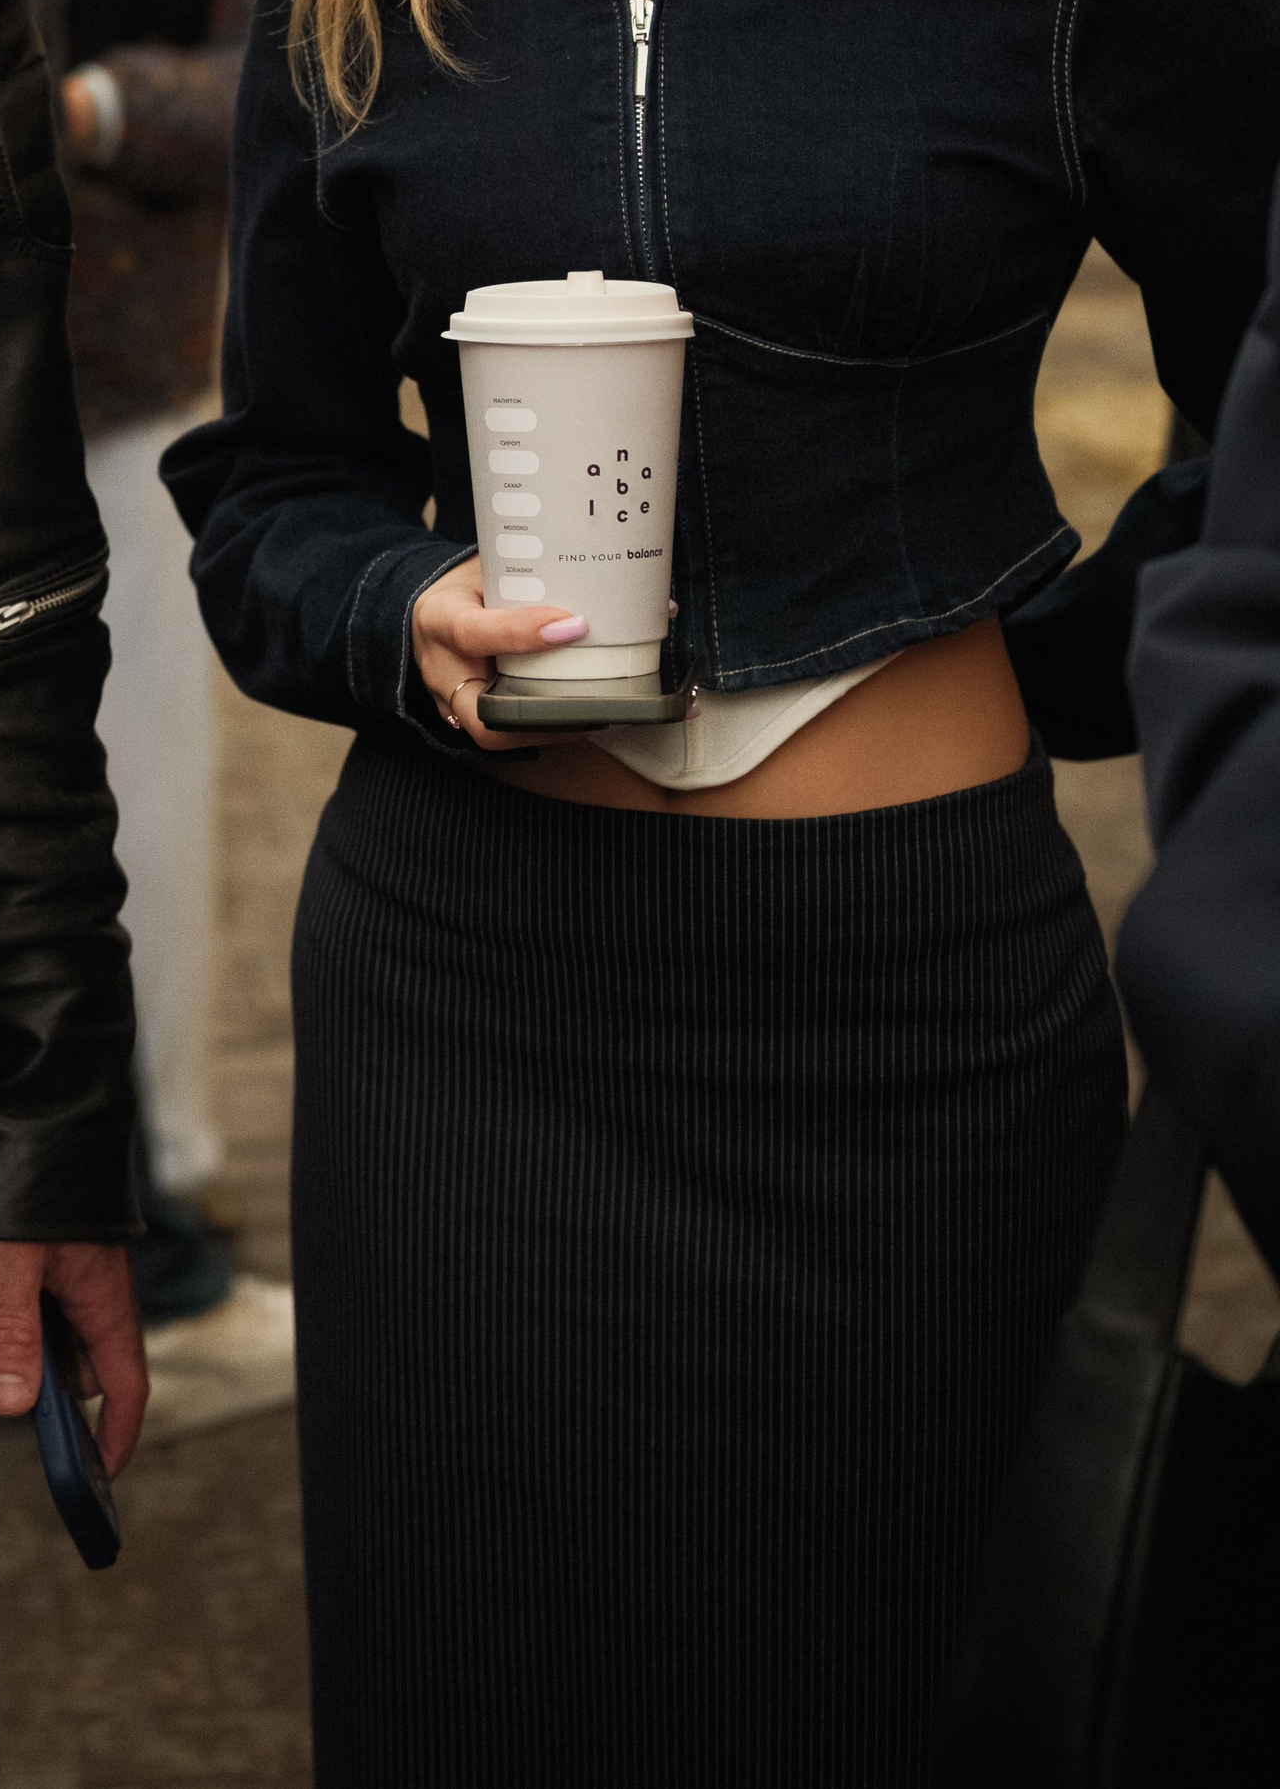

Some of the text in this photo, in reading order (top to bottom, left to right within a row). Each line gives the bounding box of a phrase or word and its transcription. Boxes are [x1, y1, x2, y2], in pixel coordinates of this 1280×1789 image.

[558, 548, 664, 562] FIND YOUR balance
